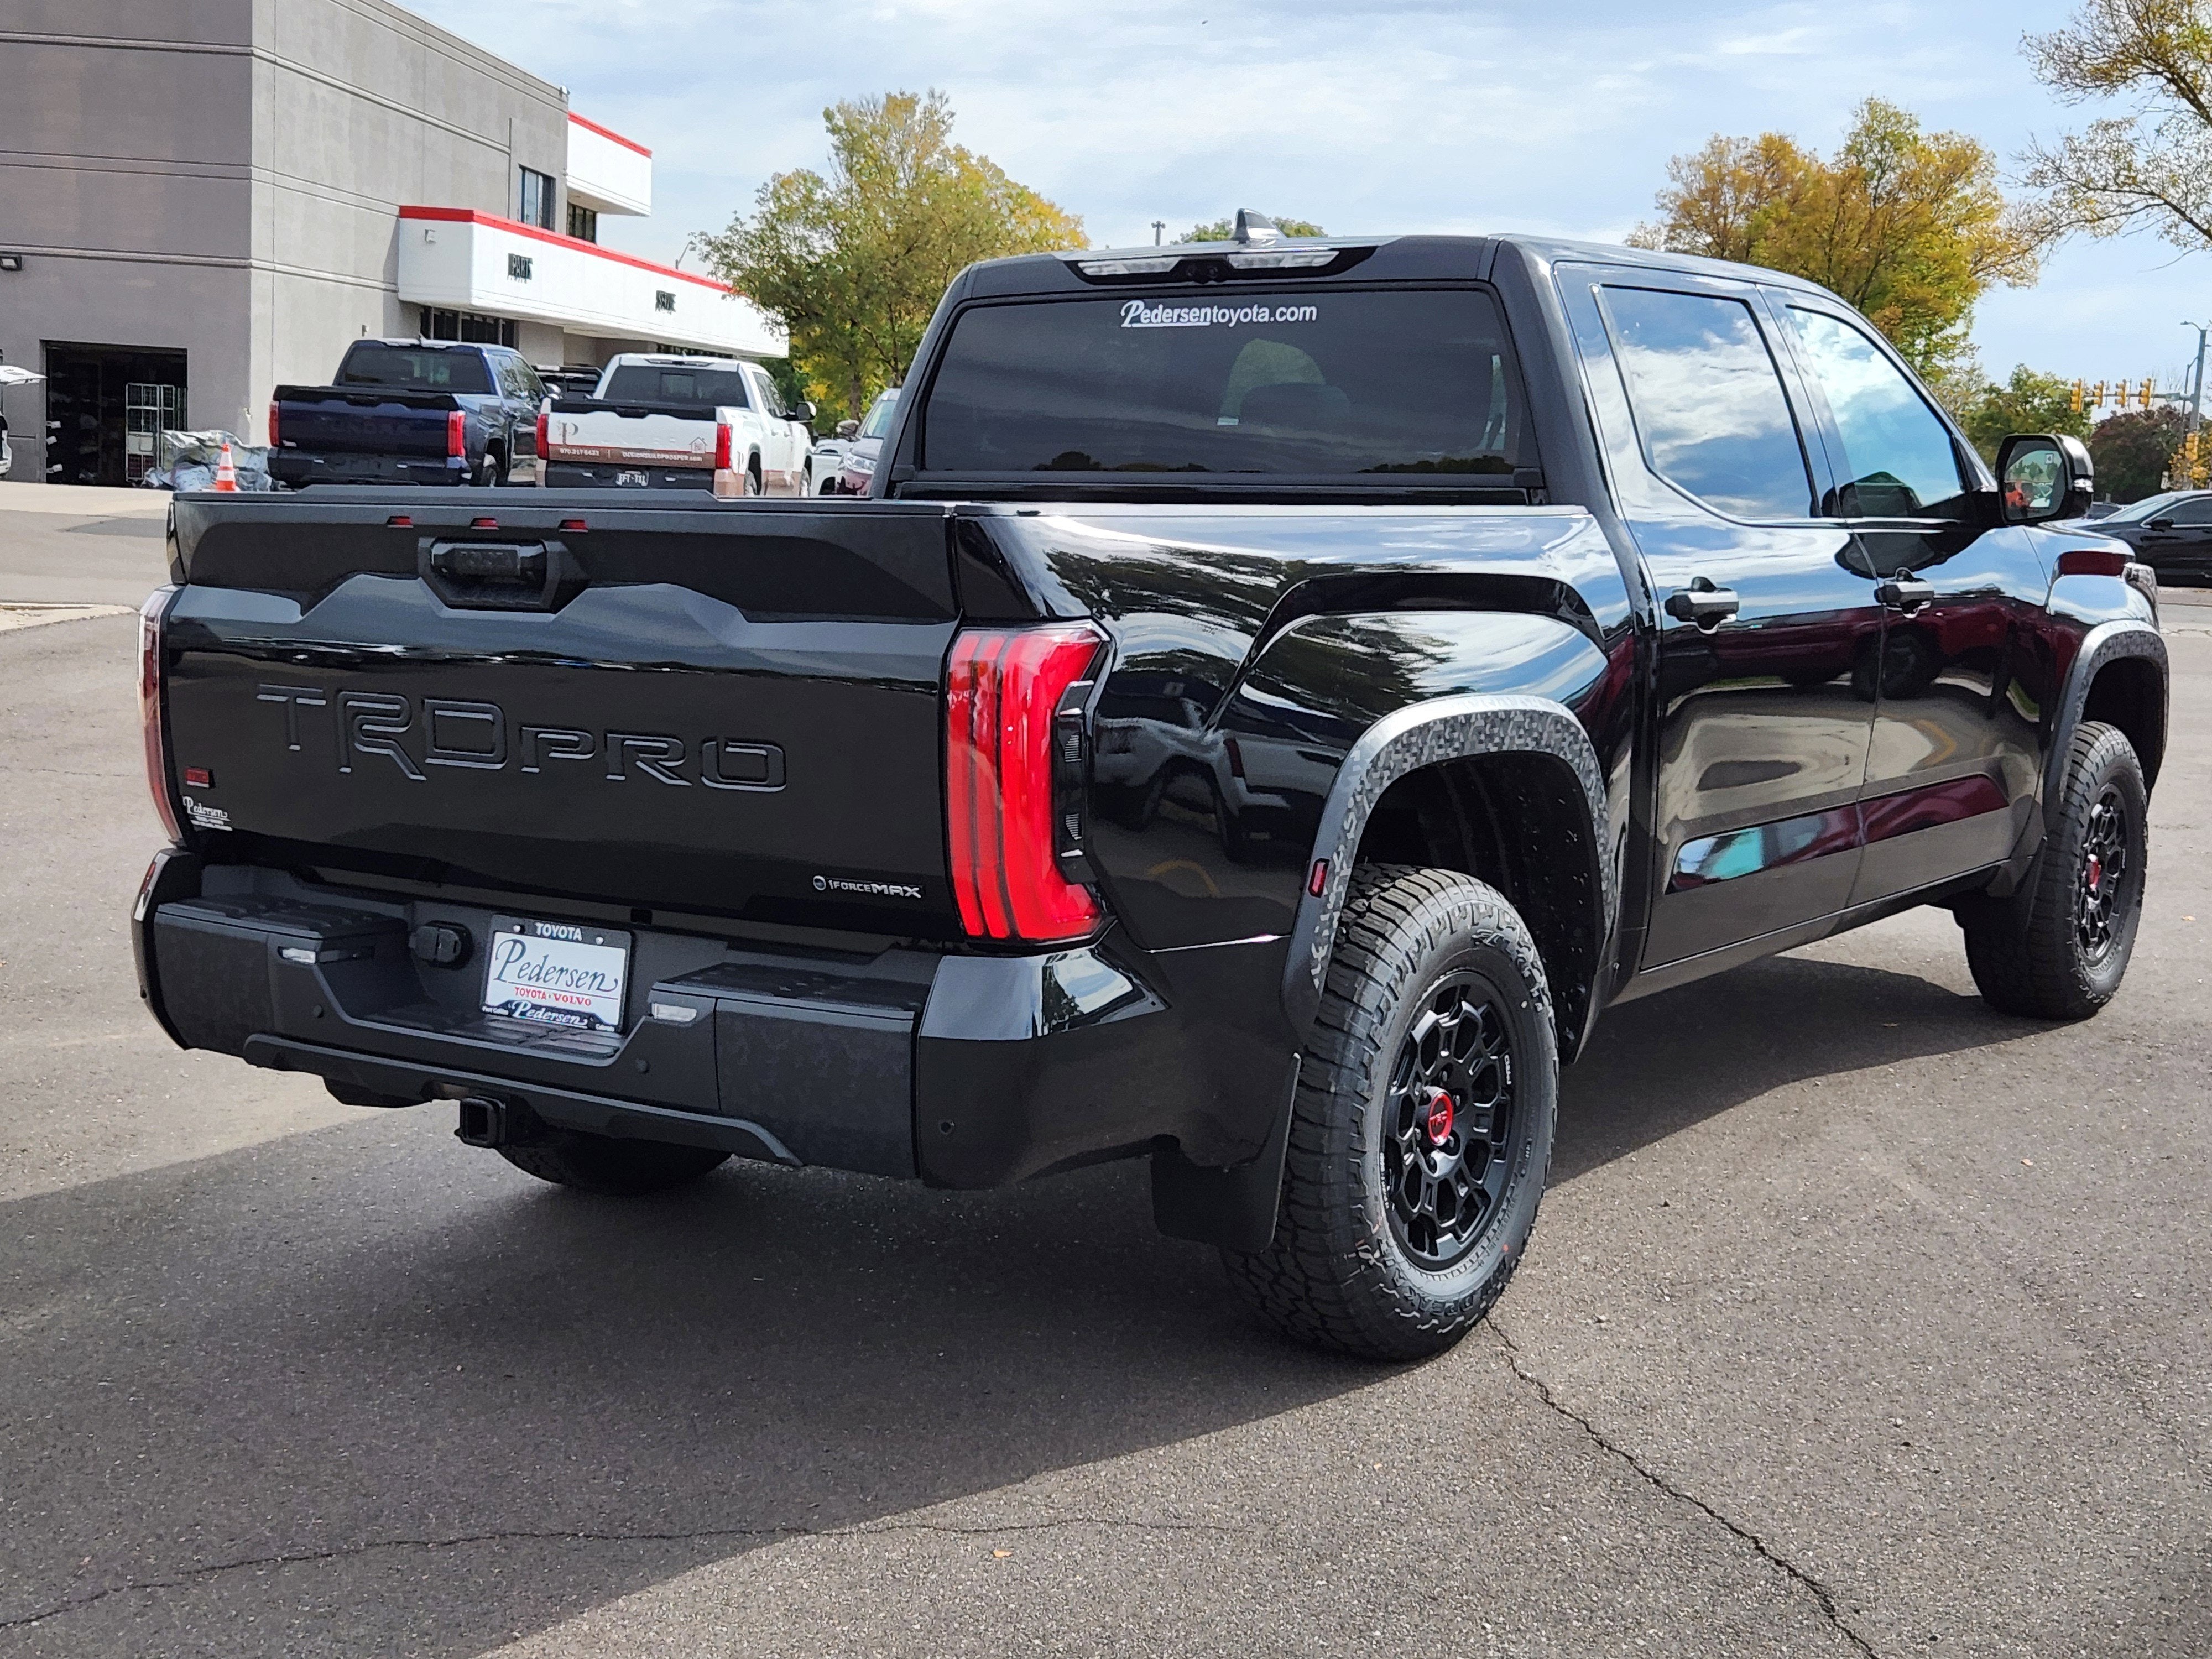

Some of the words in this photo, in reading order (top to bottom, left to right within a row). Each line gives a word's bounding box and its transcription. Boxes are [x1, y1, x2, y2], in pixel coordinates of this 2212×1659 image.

[509, 254, 533, 280] PARTS
[1121, 300, 1317, 327] Pedersentoyota.com
[256, 684, 508, 781] TRD
[520, 727, 787, 792] PRO
[182, 796, 228, 818] Pedersen
[534, 922, 583, 942] TOYOTA
[493, 938, 619, 993] Pedersen
[515, 987, 547, 1000] TOYOTA
[552, 993, 592, 1006] VOLVO
[511, 1000, 588, 1027] Pedersen
